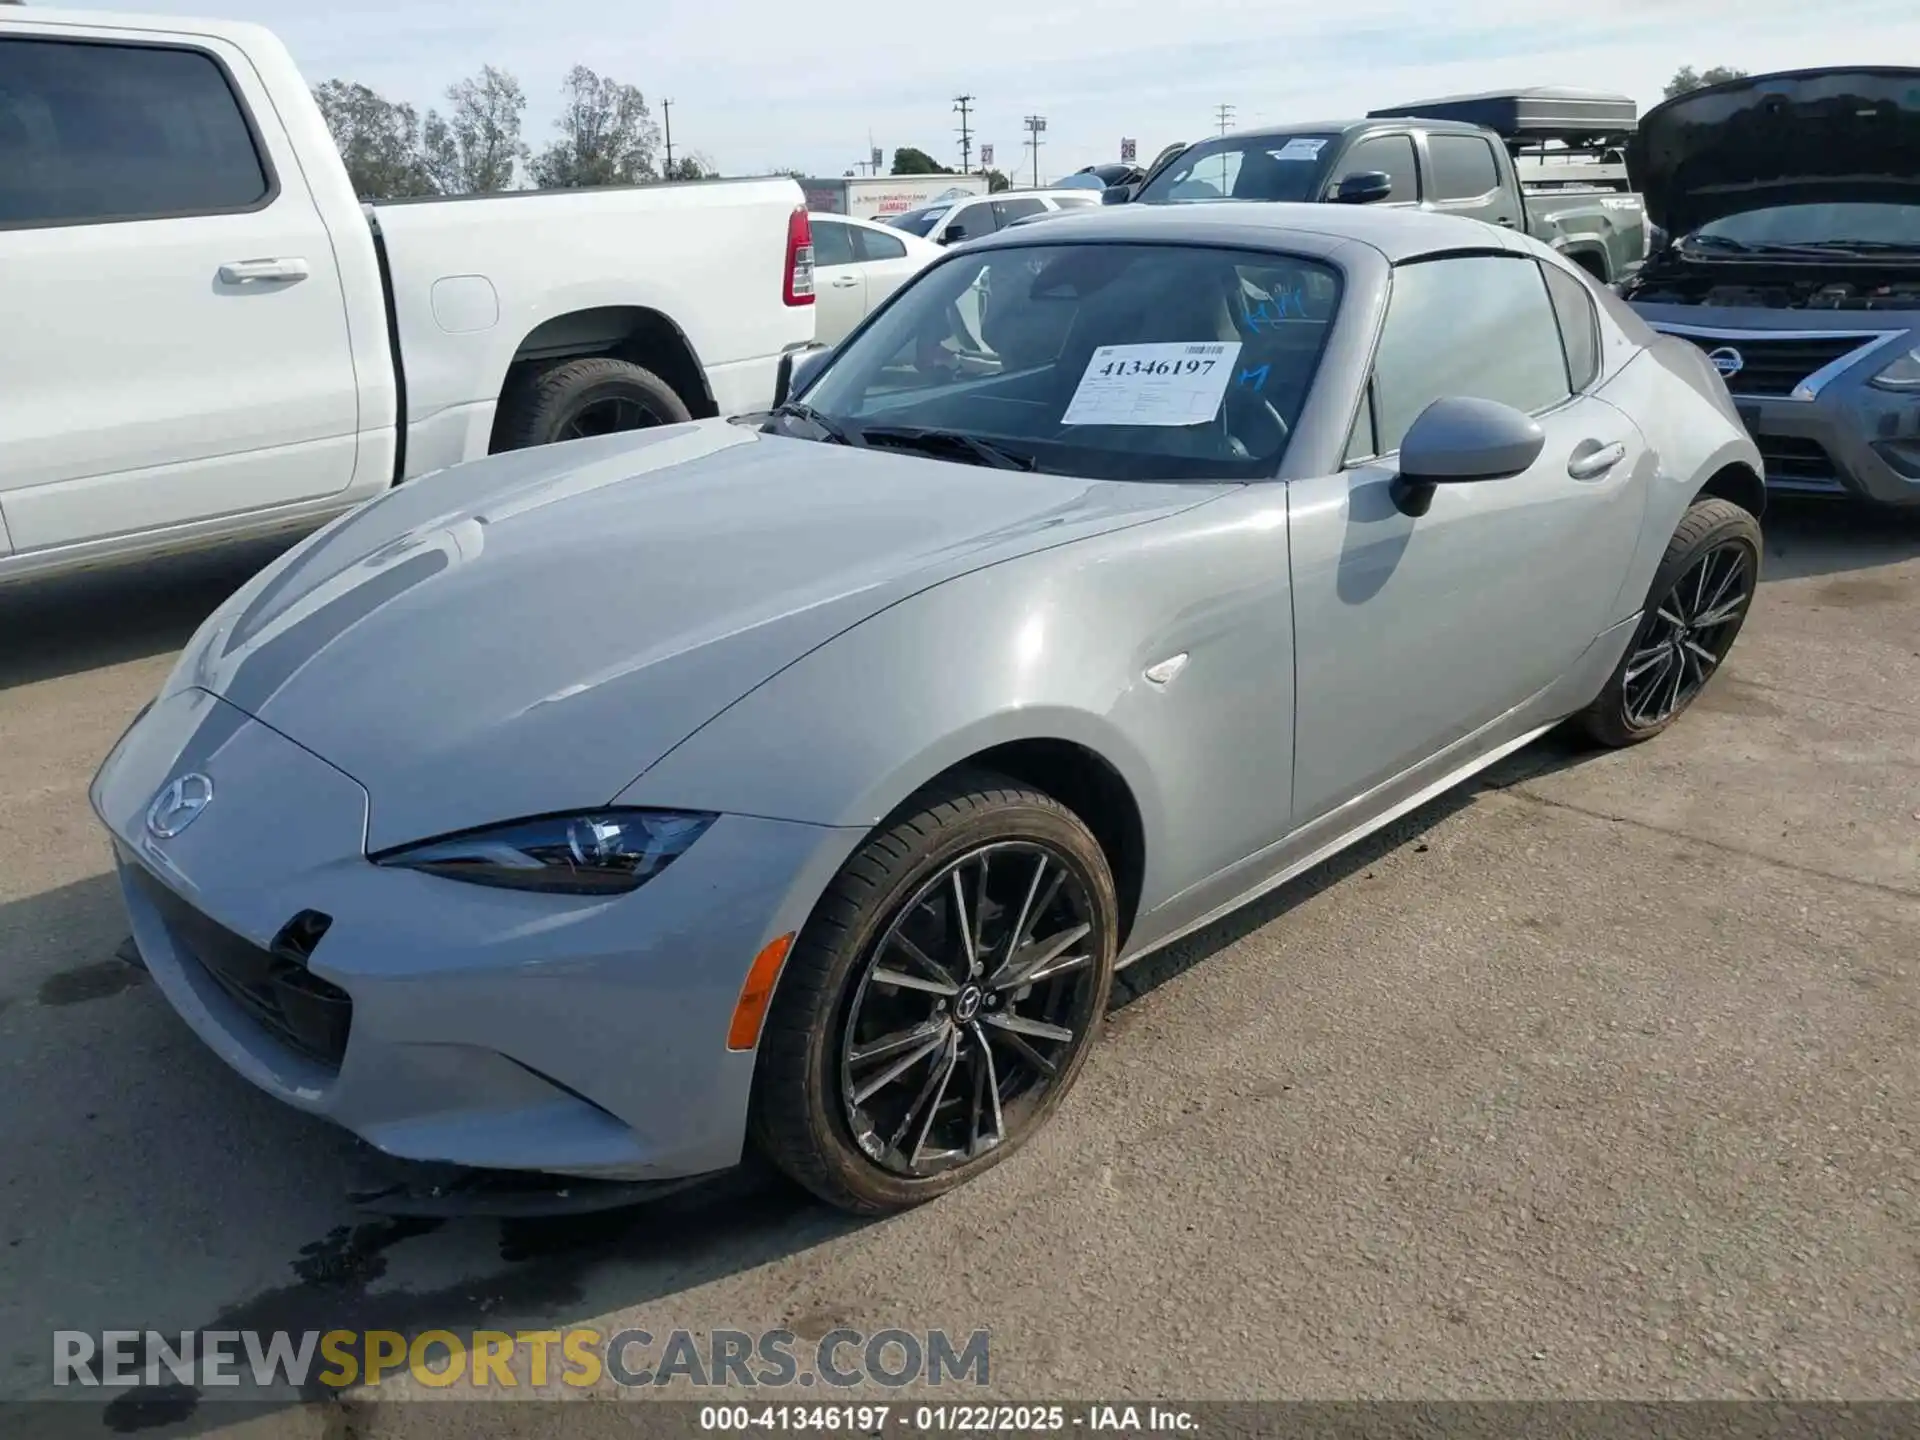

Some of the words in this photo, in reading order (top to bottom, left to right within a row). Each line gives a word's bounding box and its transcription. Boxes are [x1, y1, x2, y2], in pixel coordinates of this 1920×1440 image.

[981, 147, 993, 163] 27
[1121, 142, 1135, 159] 26
[1099, 360, 1216, 377] 41346197
